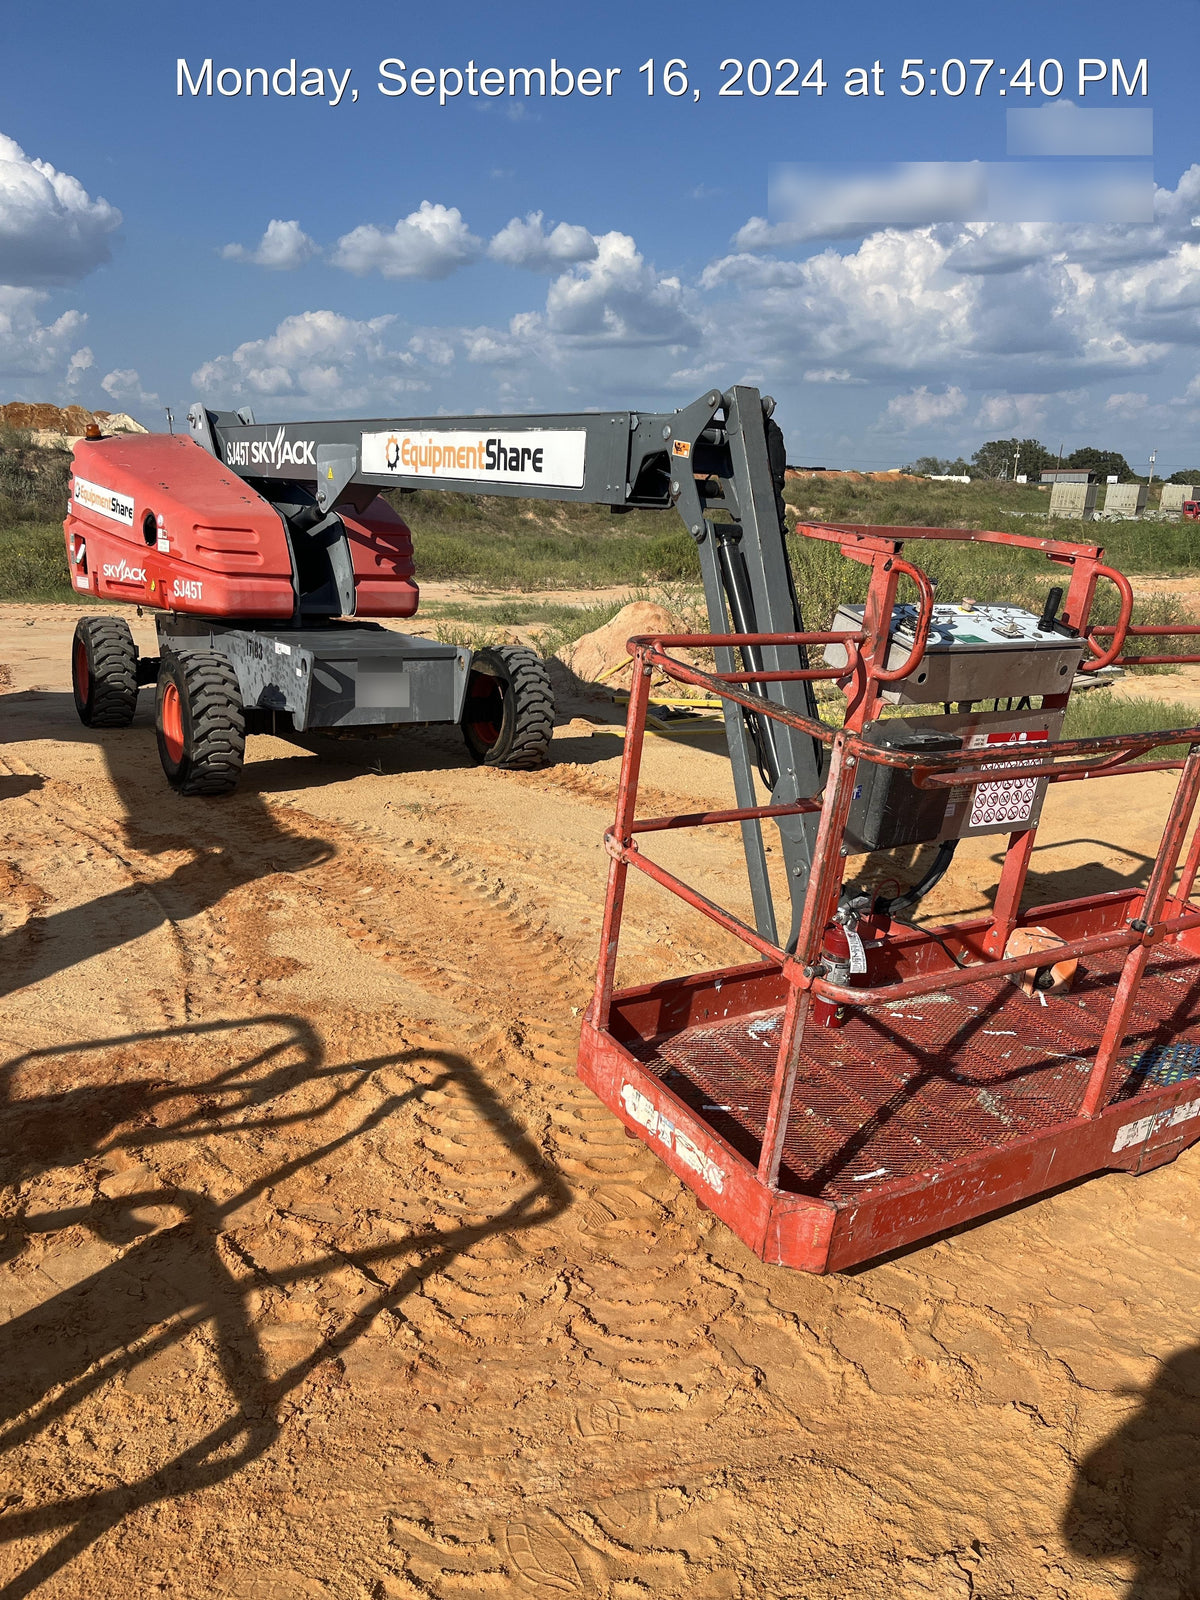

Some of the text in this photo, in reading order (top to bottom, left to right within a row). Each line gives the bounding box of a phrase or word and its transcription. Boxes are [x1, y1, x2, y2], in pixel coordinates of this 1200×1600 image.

[226, 425, 317, 470] SJ45T SKYJACK
[400, 438, 544, 474] EquipmentShare
[79, 484, 134, 520] EquipmentShare
[102, 558, 148, 583] SKYJACK
[173, 579, 204, 601] SJ45T
